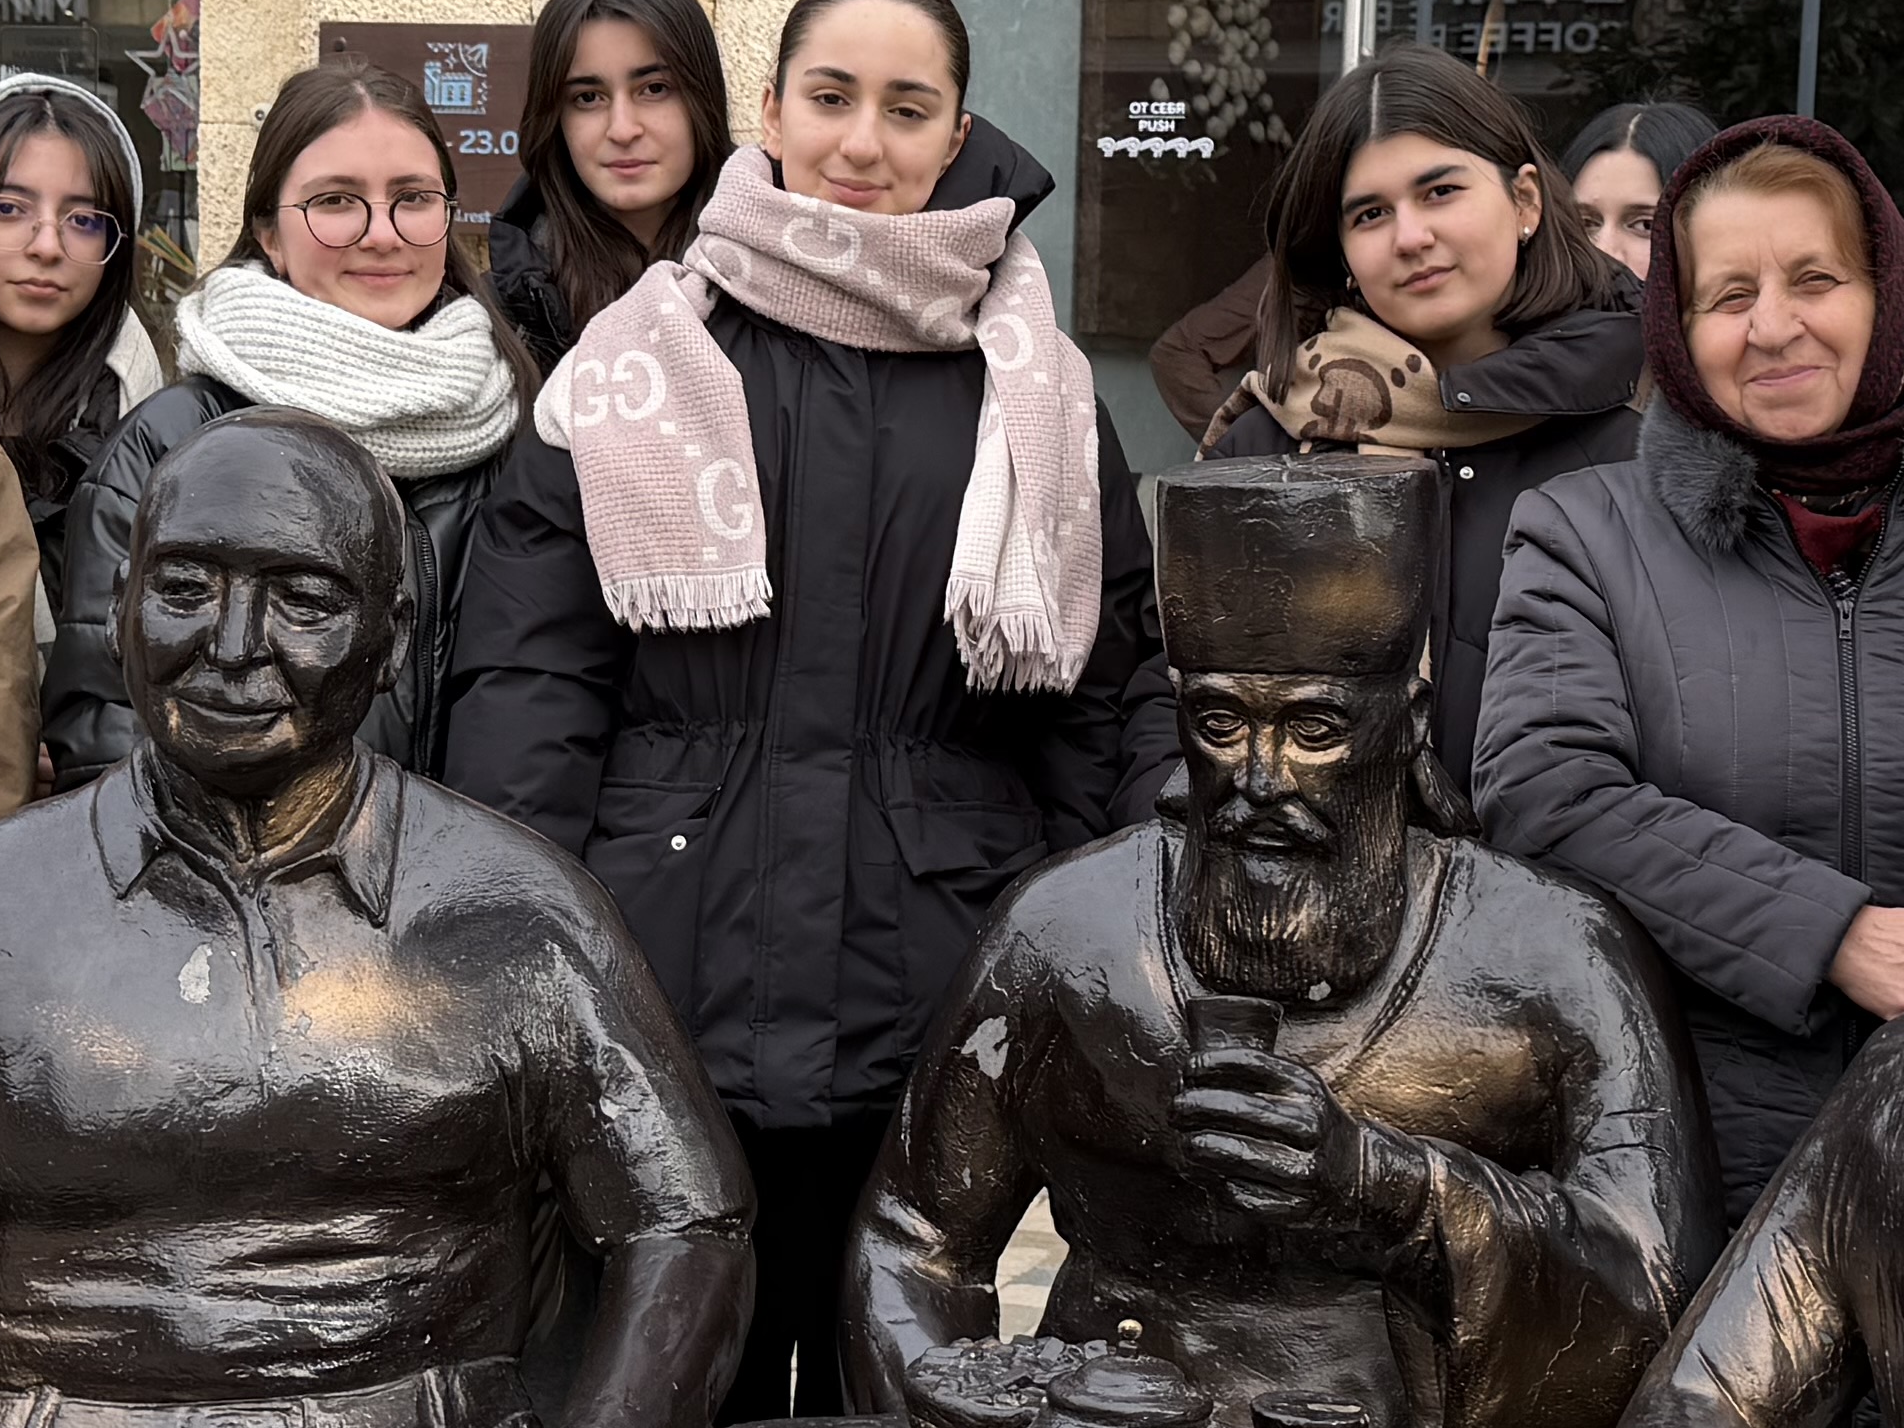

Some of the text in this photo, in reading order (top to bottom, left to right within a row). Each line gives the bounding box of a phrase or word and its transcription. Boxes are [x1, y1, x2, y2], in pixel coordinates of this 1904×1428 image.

[1129, 101, 1186, 114] ОТ СЕБЯ
[1138, 119, 1175, 132] PUSH
[459, 130, 519, 155] 23.0
